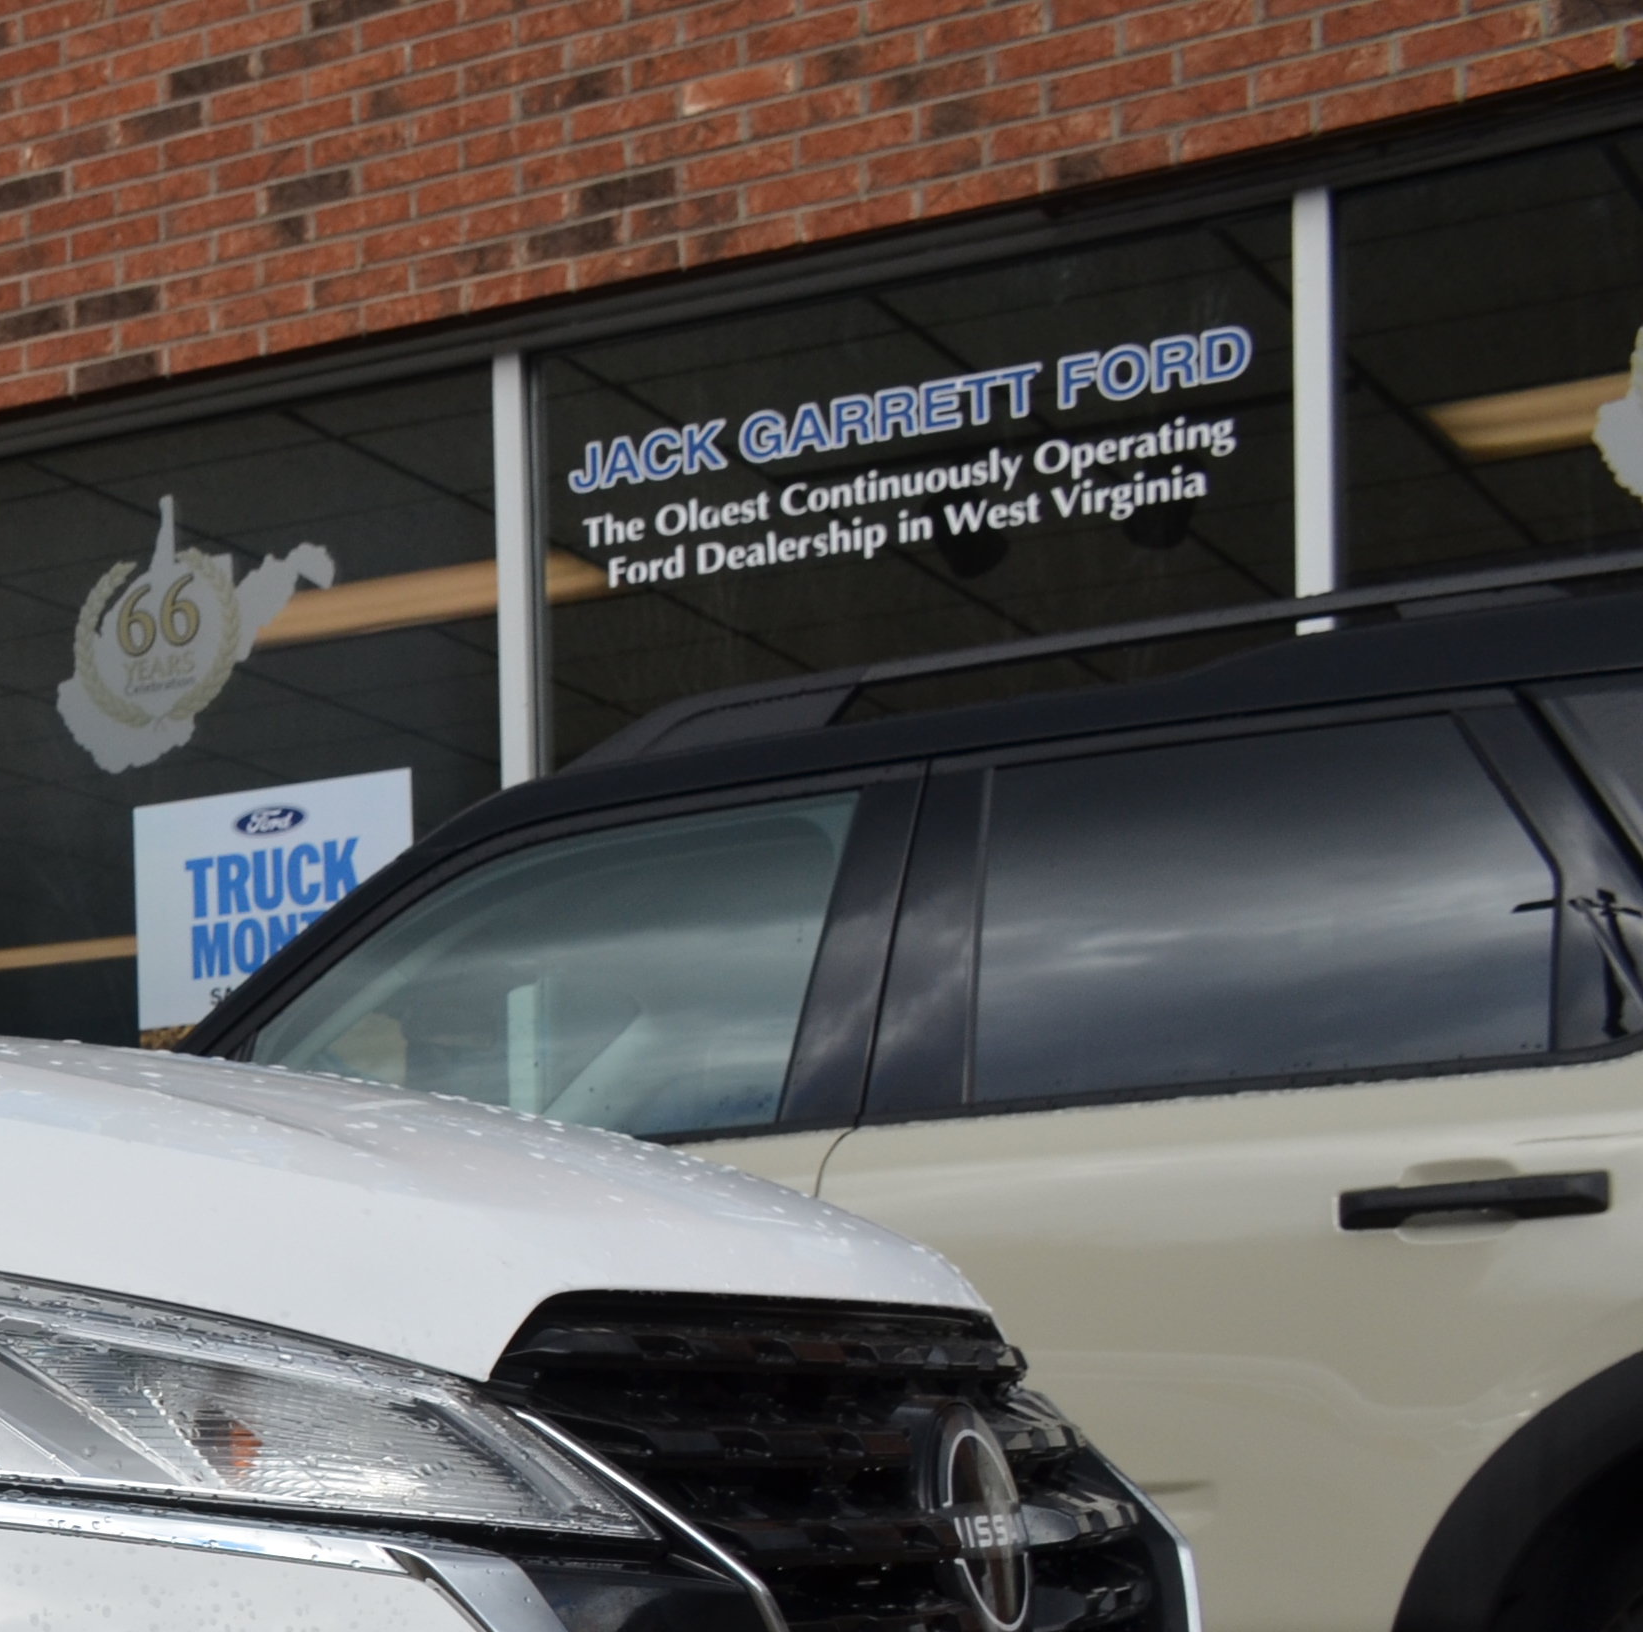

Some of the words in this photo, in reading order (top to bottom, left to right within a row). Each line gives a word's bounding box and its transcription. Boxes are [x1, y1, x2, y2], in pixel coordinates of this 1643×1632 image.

[568, 418, 728, 494] JACK
[739, 362, 1043, 464] GARRETT
[1057, 326, 1253, 410] FORD
[582, 513, 646, 549] The
[780, 447, 1023, 516] Continuously
[1033, 416, 1237, 481] Operating
[608, 544, 686, 588] Ford
[696, 516, 888, 575] Dealership
[898, 509, 934, 544] in
[943, 492, 1043, 535] West
[1050, 465, 1208, 521] Virginia
[116, 572, 201, 658] 66
[123, 651, 196, 682] YEARS
[185, 837, 360, 919] TRUCK
[192, 909, 330, 980] MON
